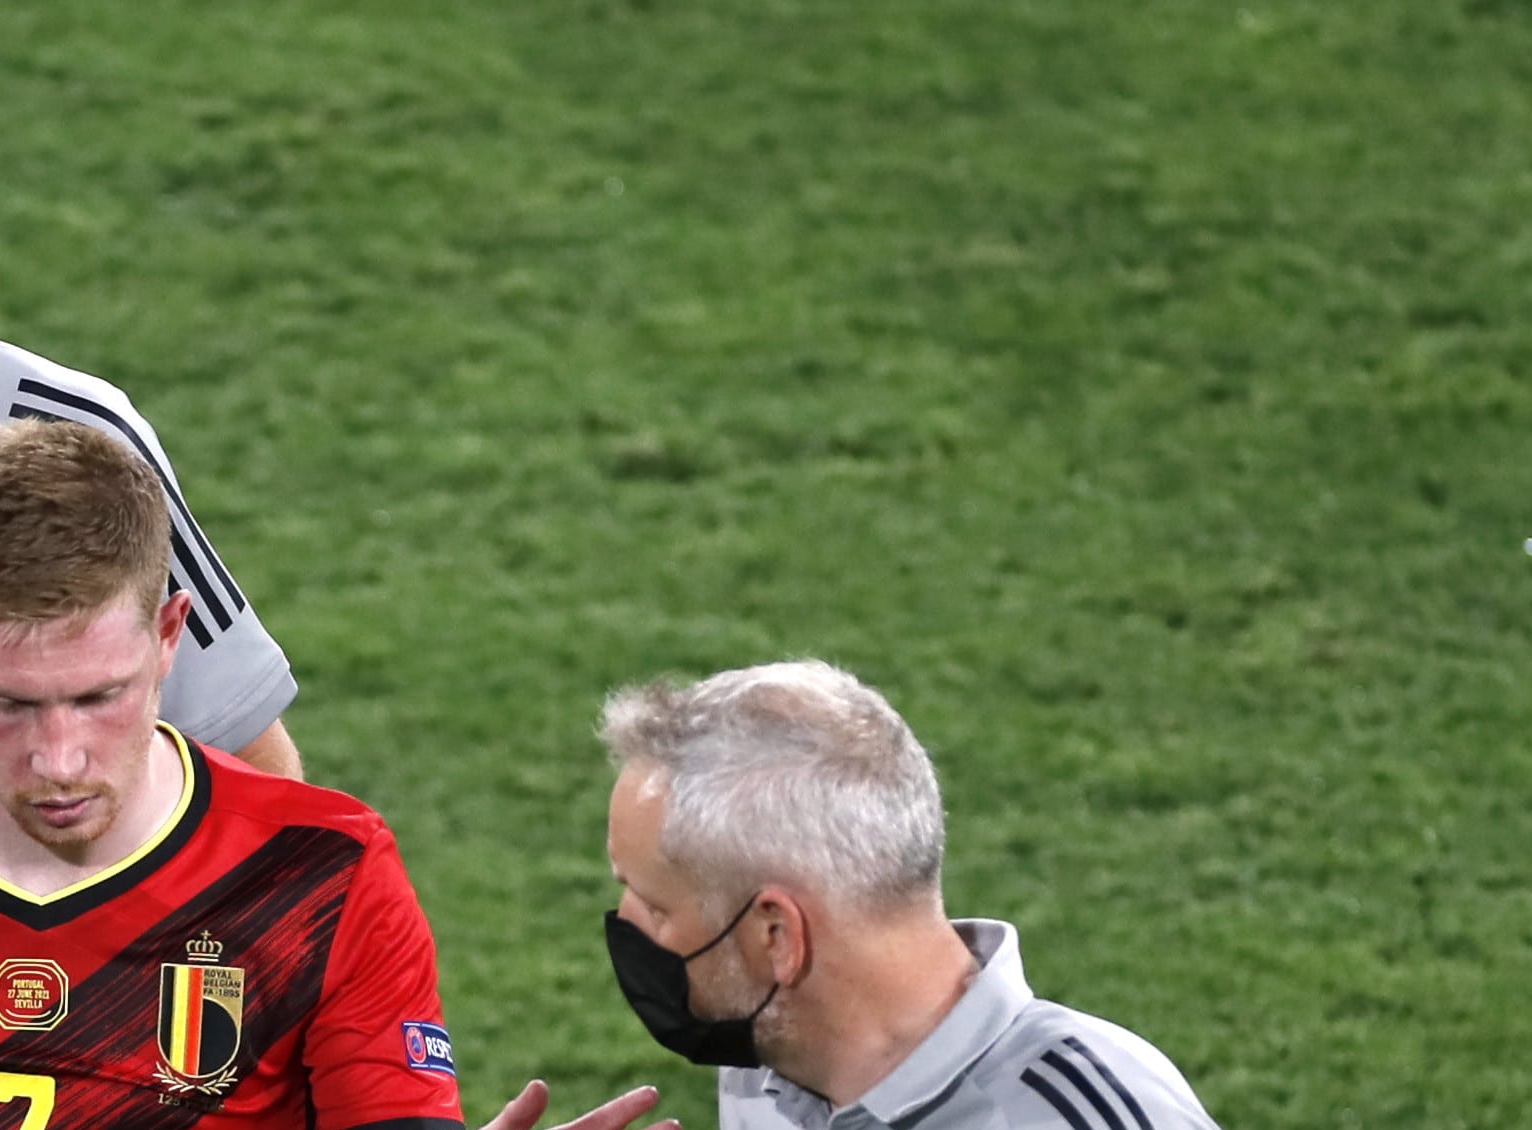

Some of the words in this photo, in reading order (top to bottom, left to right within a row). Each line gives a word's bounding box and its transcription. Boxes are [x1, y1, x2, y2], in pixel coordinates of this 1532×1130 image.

[204, 968, 231, 979] ROYAL
[13, 980, 44, 989] PORTUGAL
[204, 979, 241, 988] BELGIAN
[8, 989, 16, 998] 27
[17, 989, 33, 998] JUNE
[14, 999, 43, 1009] SEVILLA
